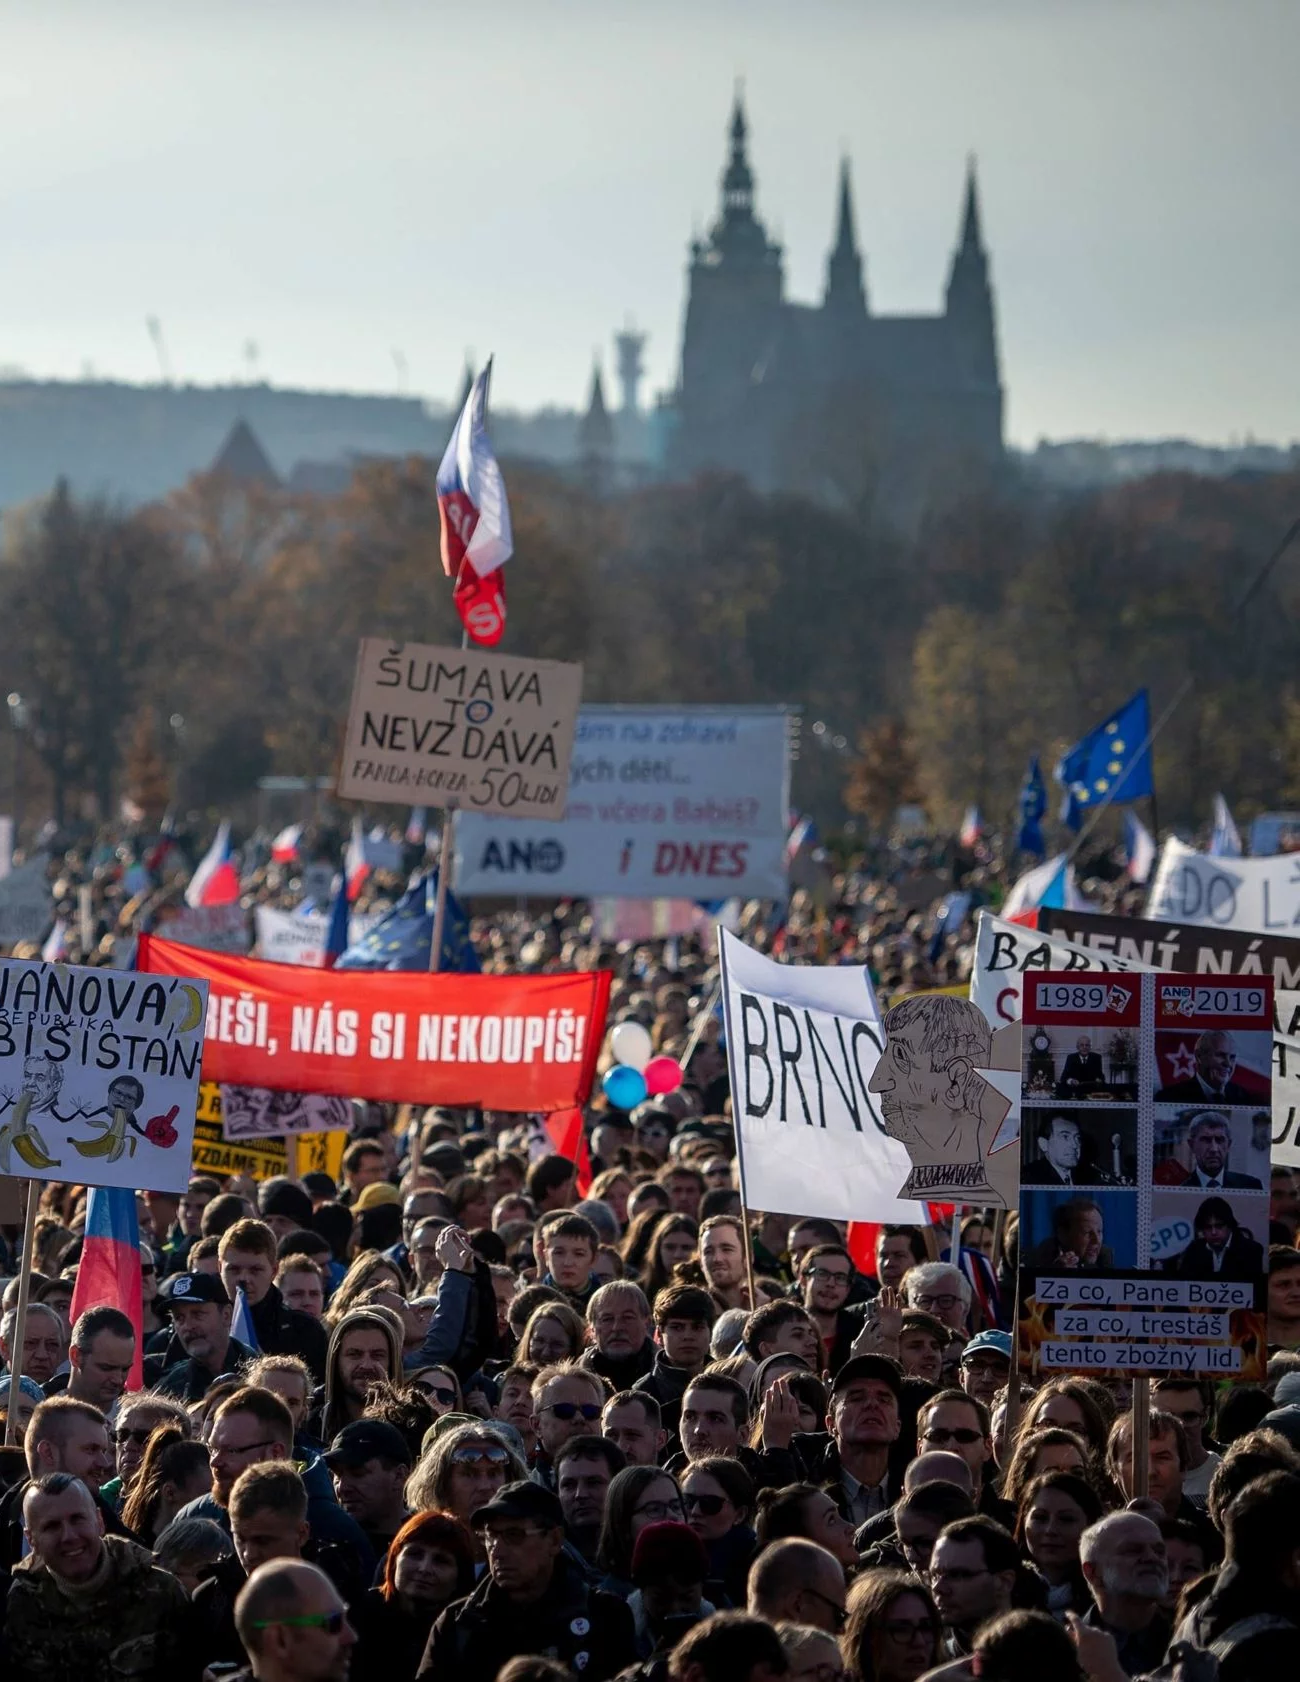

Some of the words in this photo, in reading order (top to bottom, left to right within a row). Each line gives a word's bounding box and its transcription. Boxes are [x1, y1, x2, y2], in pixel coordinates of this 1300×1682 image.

[376, 648, 542, 707] ŠUMAVA
[444, 697, 494, 724] TO
[653, 840, 749, 879] DNES
[1040, 986, 1103, 1009] 1989
[1162, 987, 1191, 998] ANO
[1198, 990, 1263, 1012] 2019
[291, 1001, 360, 1057] NÁS
[370, 1011, 406, 1060] SI
[417, 1008, 587, 1065] NEKOUPÍŠ!
[1041, 1281, 1070, 1300] Za
[1079, 1284, 1112, 1305] co,
[1123, 1282, 1179, 1302] Pane
[1189, 1283, 1251, 1308] Bože,
[1063, 1316, 1089, 1332] za
[1098, 1318, 1131, 1337] co,
[1141, 1315, 1222, 1336] trestáš
[1046, 1345, 1107, 1364] tento
[1116, 1347, 1197, 1371] zbožný
[1206, 1348, 1241, 1368] lid.
